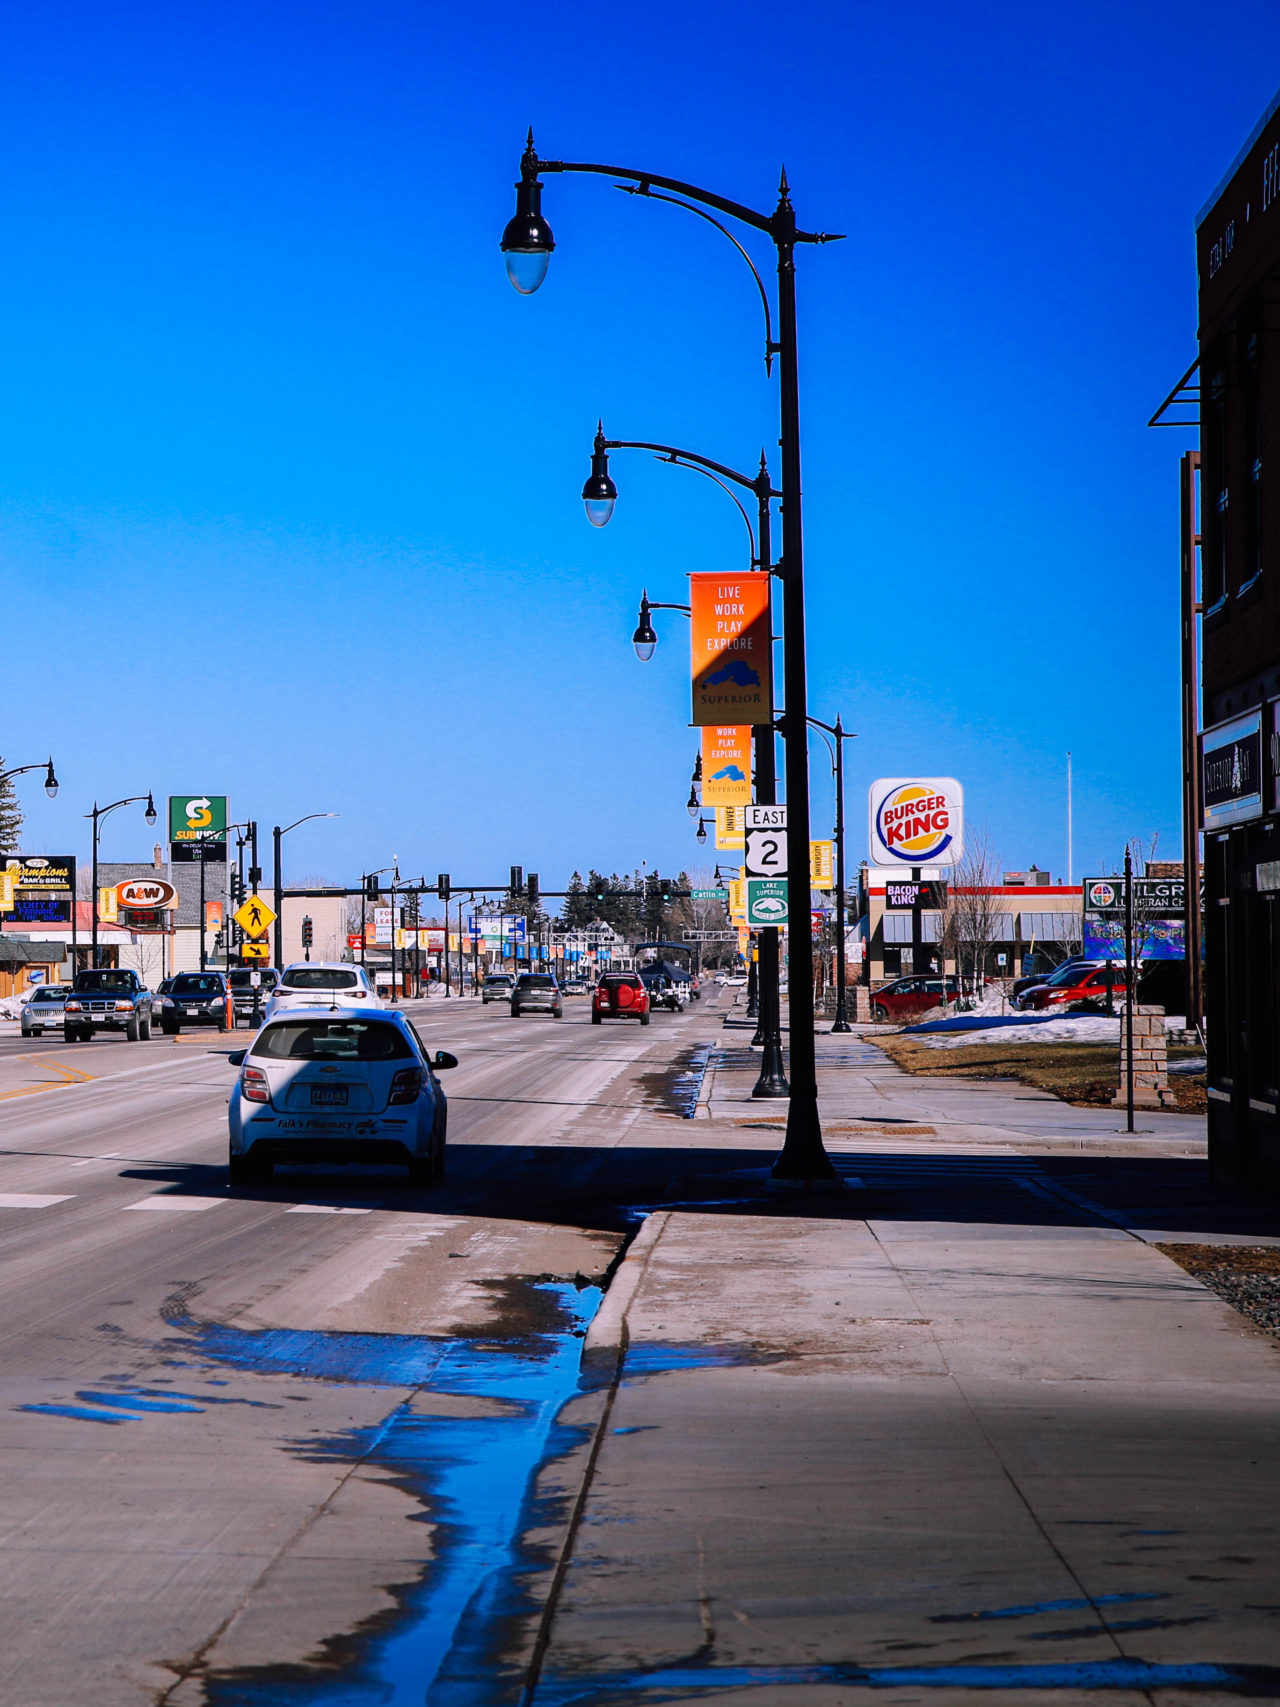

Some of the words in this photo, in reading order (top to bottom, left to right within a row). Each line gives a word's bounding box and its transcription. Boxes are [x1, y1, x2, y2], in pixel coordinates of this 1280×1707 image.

[718, 586, 740, 599] LIVE
[714, 603, 745, 616] WORK
[717, 620, 743, 633] PLAY
[707, 637, 753, 651] EXPLORE
[701, 693, 762, 704] SUPERIOR
[716, 728, 737, 736] WORK
[718, 739, 735, 747] PLAY
[711, 750, 742, 758] EXPLORE
[752, 809, 786, 825] EAST
[884, 795, 946, 826] BURGER
[886, 810, 949, 847] KING
[761, 840, 778, 865] 2
[6, 863, 69, 880] Champions
[126, 887, 160, 900] A&W
[756, 889, 784, 897] SUPERIOR
[887, 885, 919, 895] BACON
[891, 894, 916, 905] KING
[306, 1119, 354, 1130] Pharmacy
